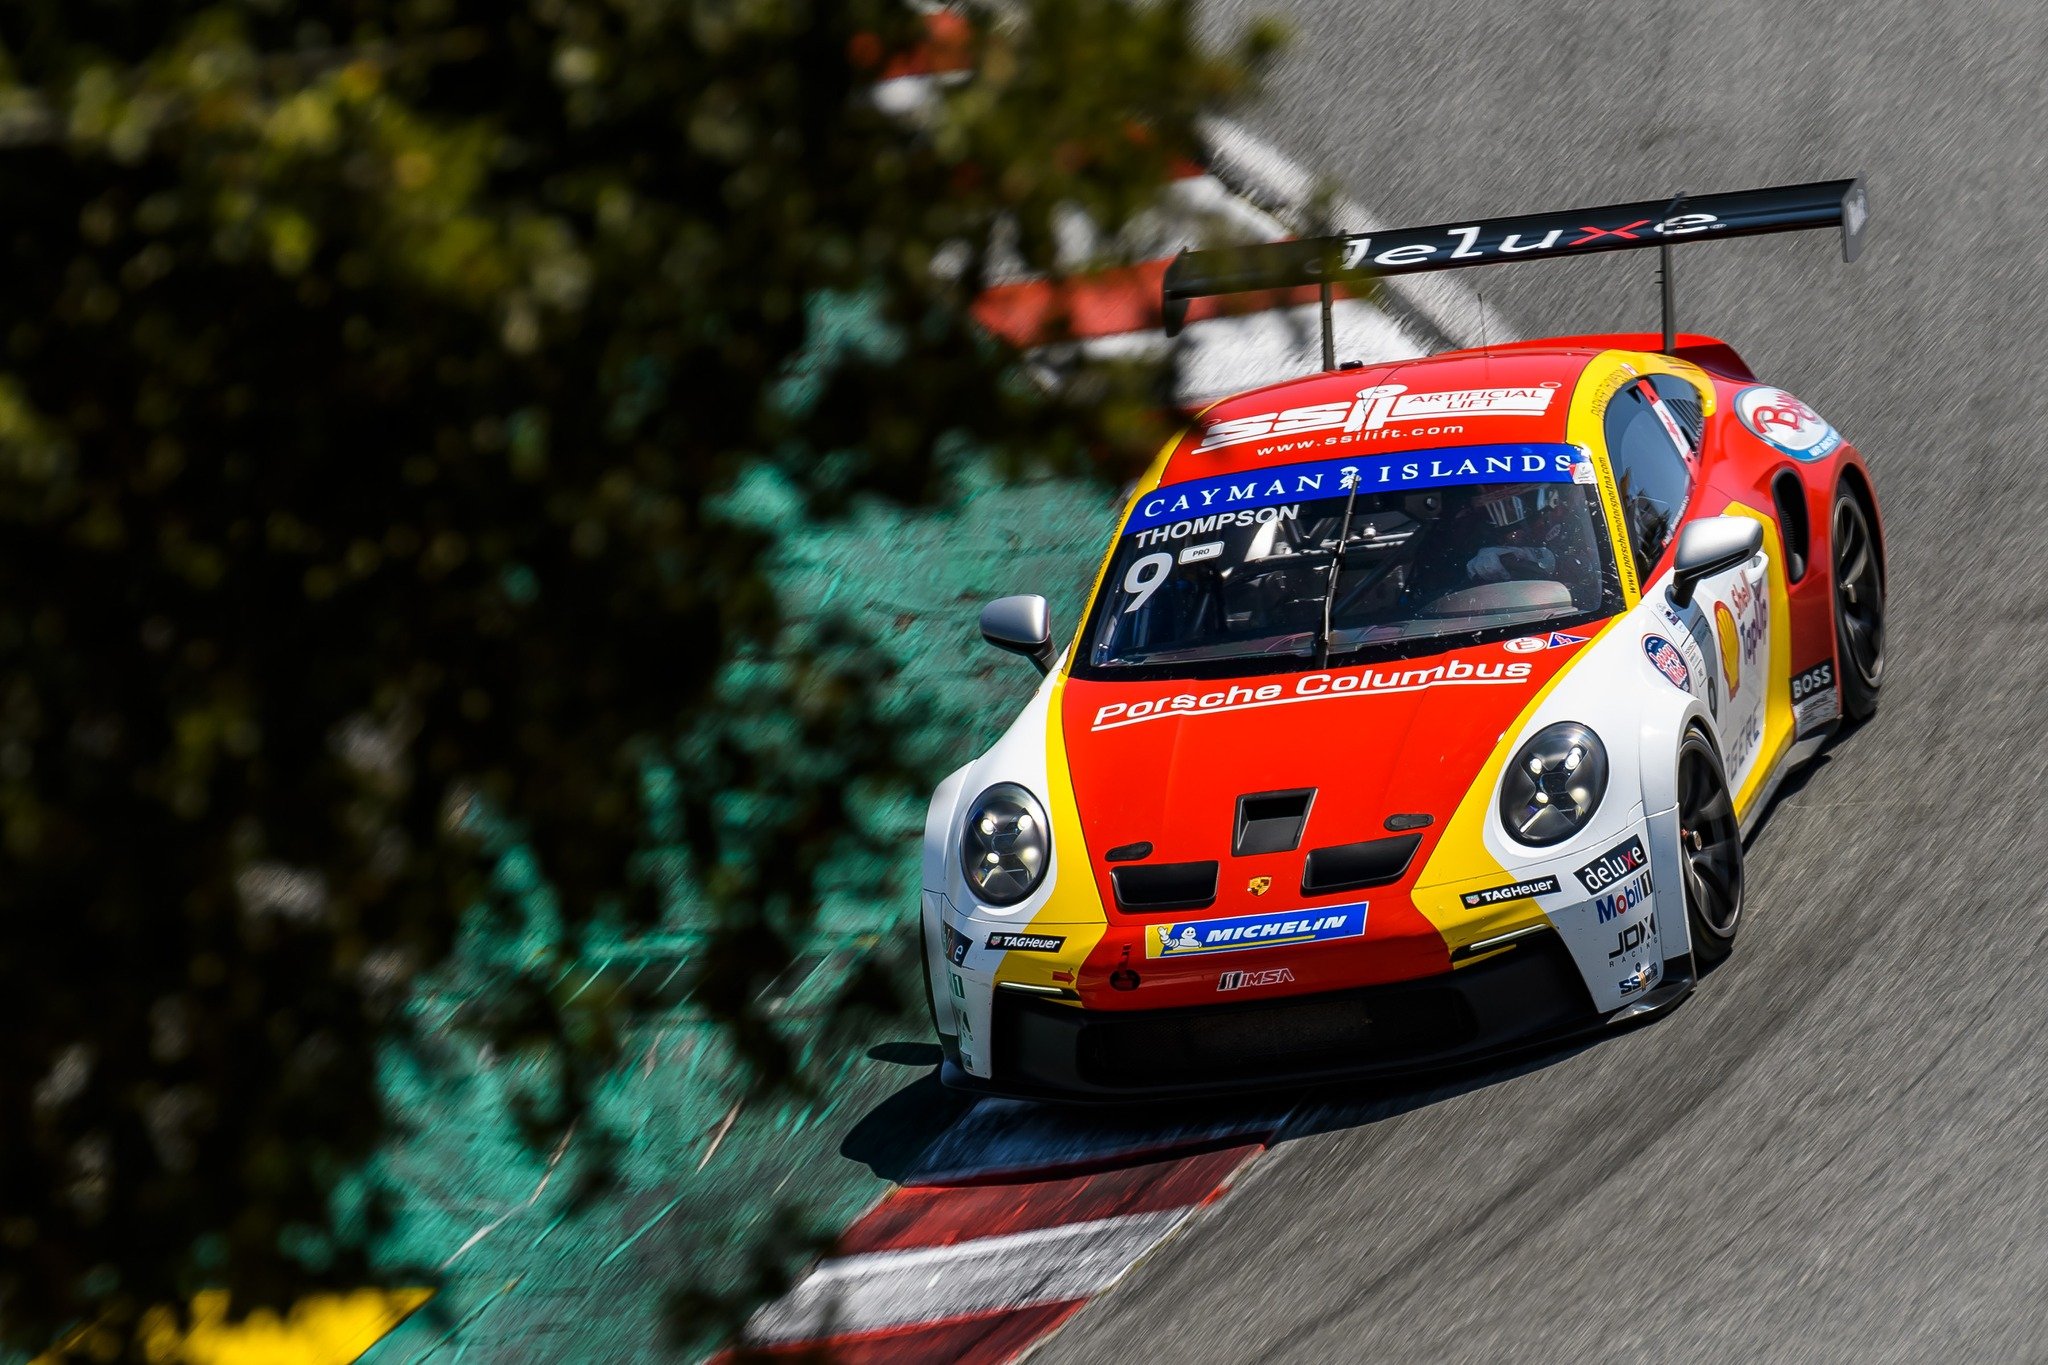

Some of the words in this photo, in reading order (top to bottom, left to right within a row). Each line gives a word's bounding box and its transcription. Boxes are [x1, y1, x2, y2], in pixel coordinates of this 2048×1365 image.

[1407, 389, 1543, 403] ARTIFICIAL
[1446, 400, 1493, 409] LIFT
[1256, 425, 1464, 456] www.ssilift.com
[1144, 474, 1324, 517] CAYMAN
[1378, 455, 1571, 482] ISLANDS
[1136, 504, 1300, 549] THOMPSON
[1123, 552, 1173, 613] 9
[1192, 548, 1210, 557] PRO
[1093, 683, 1283, 726] Porsche
[1294, 659, 1534, 697] Columbus
[1792, 665, 1831, 699] BOSS
[1585, 846, 1645, 890] deluxe
[1206, 914, 1347, 944] MICHELIN
[1608, 913, 1656, 960] JDX
[1609, 937, 1658, 968] RACING
